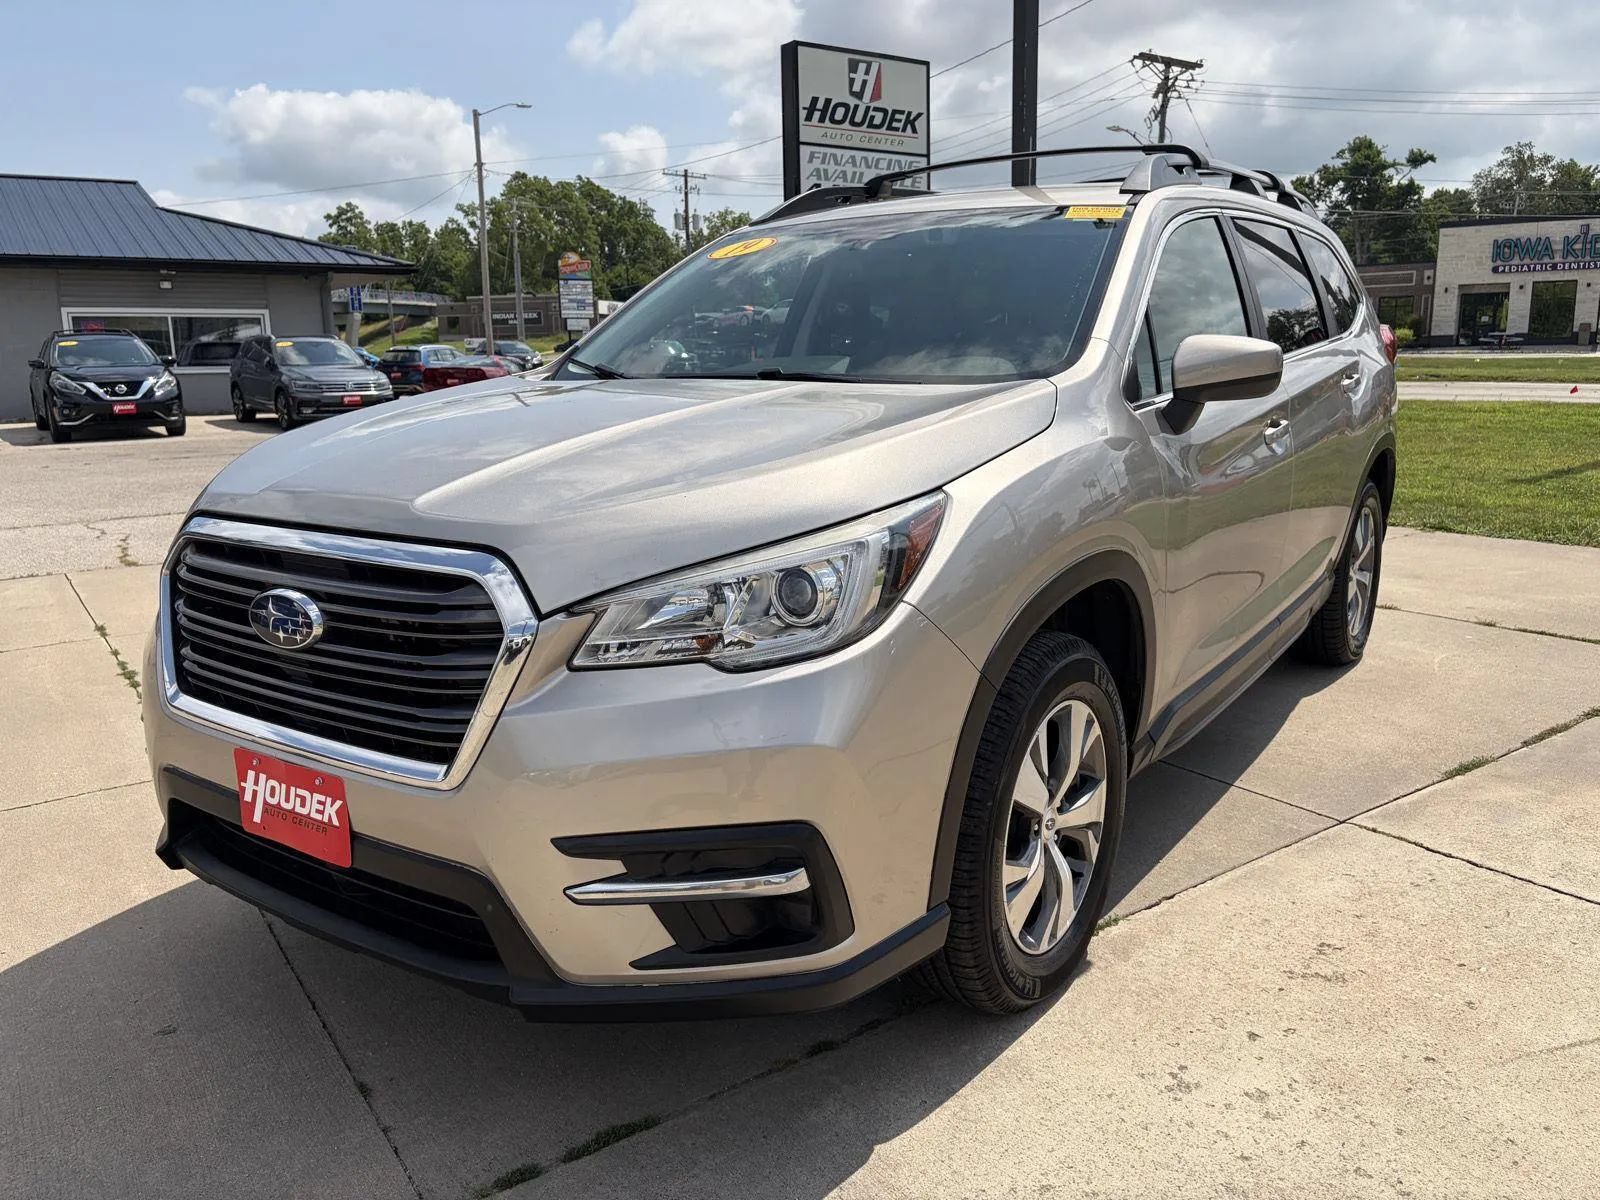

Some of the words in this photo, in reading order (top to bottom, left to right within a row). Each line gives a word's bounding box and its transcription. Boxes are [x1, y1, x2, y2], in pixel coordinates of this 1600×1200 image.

[802, 96, 924, 134] HOUDEK
[820, 132, 854, 141] AUTO
[859, 136, 904, 147] CENTER
[806, 167, 923, 189] AVAILLE
[1491, 236, 1554, 263] IOWA
[1498, 263, 1552, 273] PEDIATRIC
[240, 769, 343, 827] HOUDEK
[264, 808, 288, 821] AUTO
[291, 816, 328, 836] CENTER
